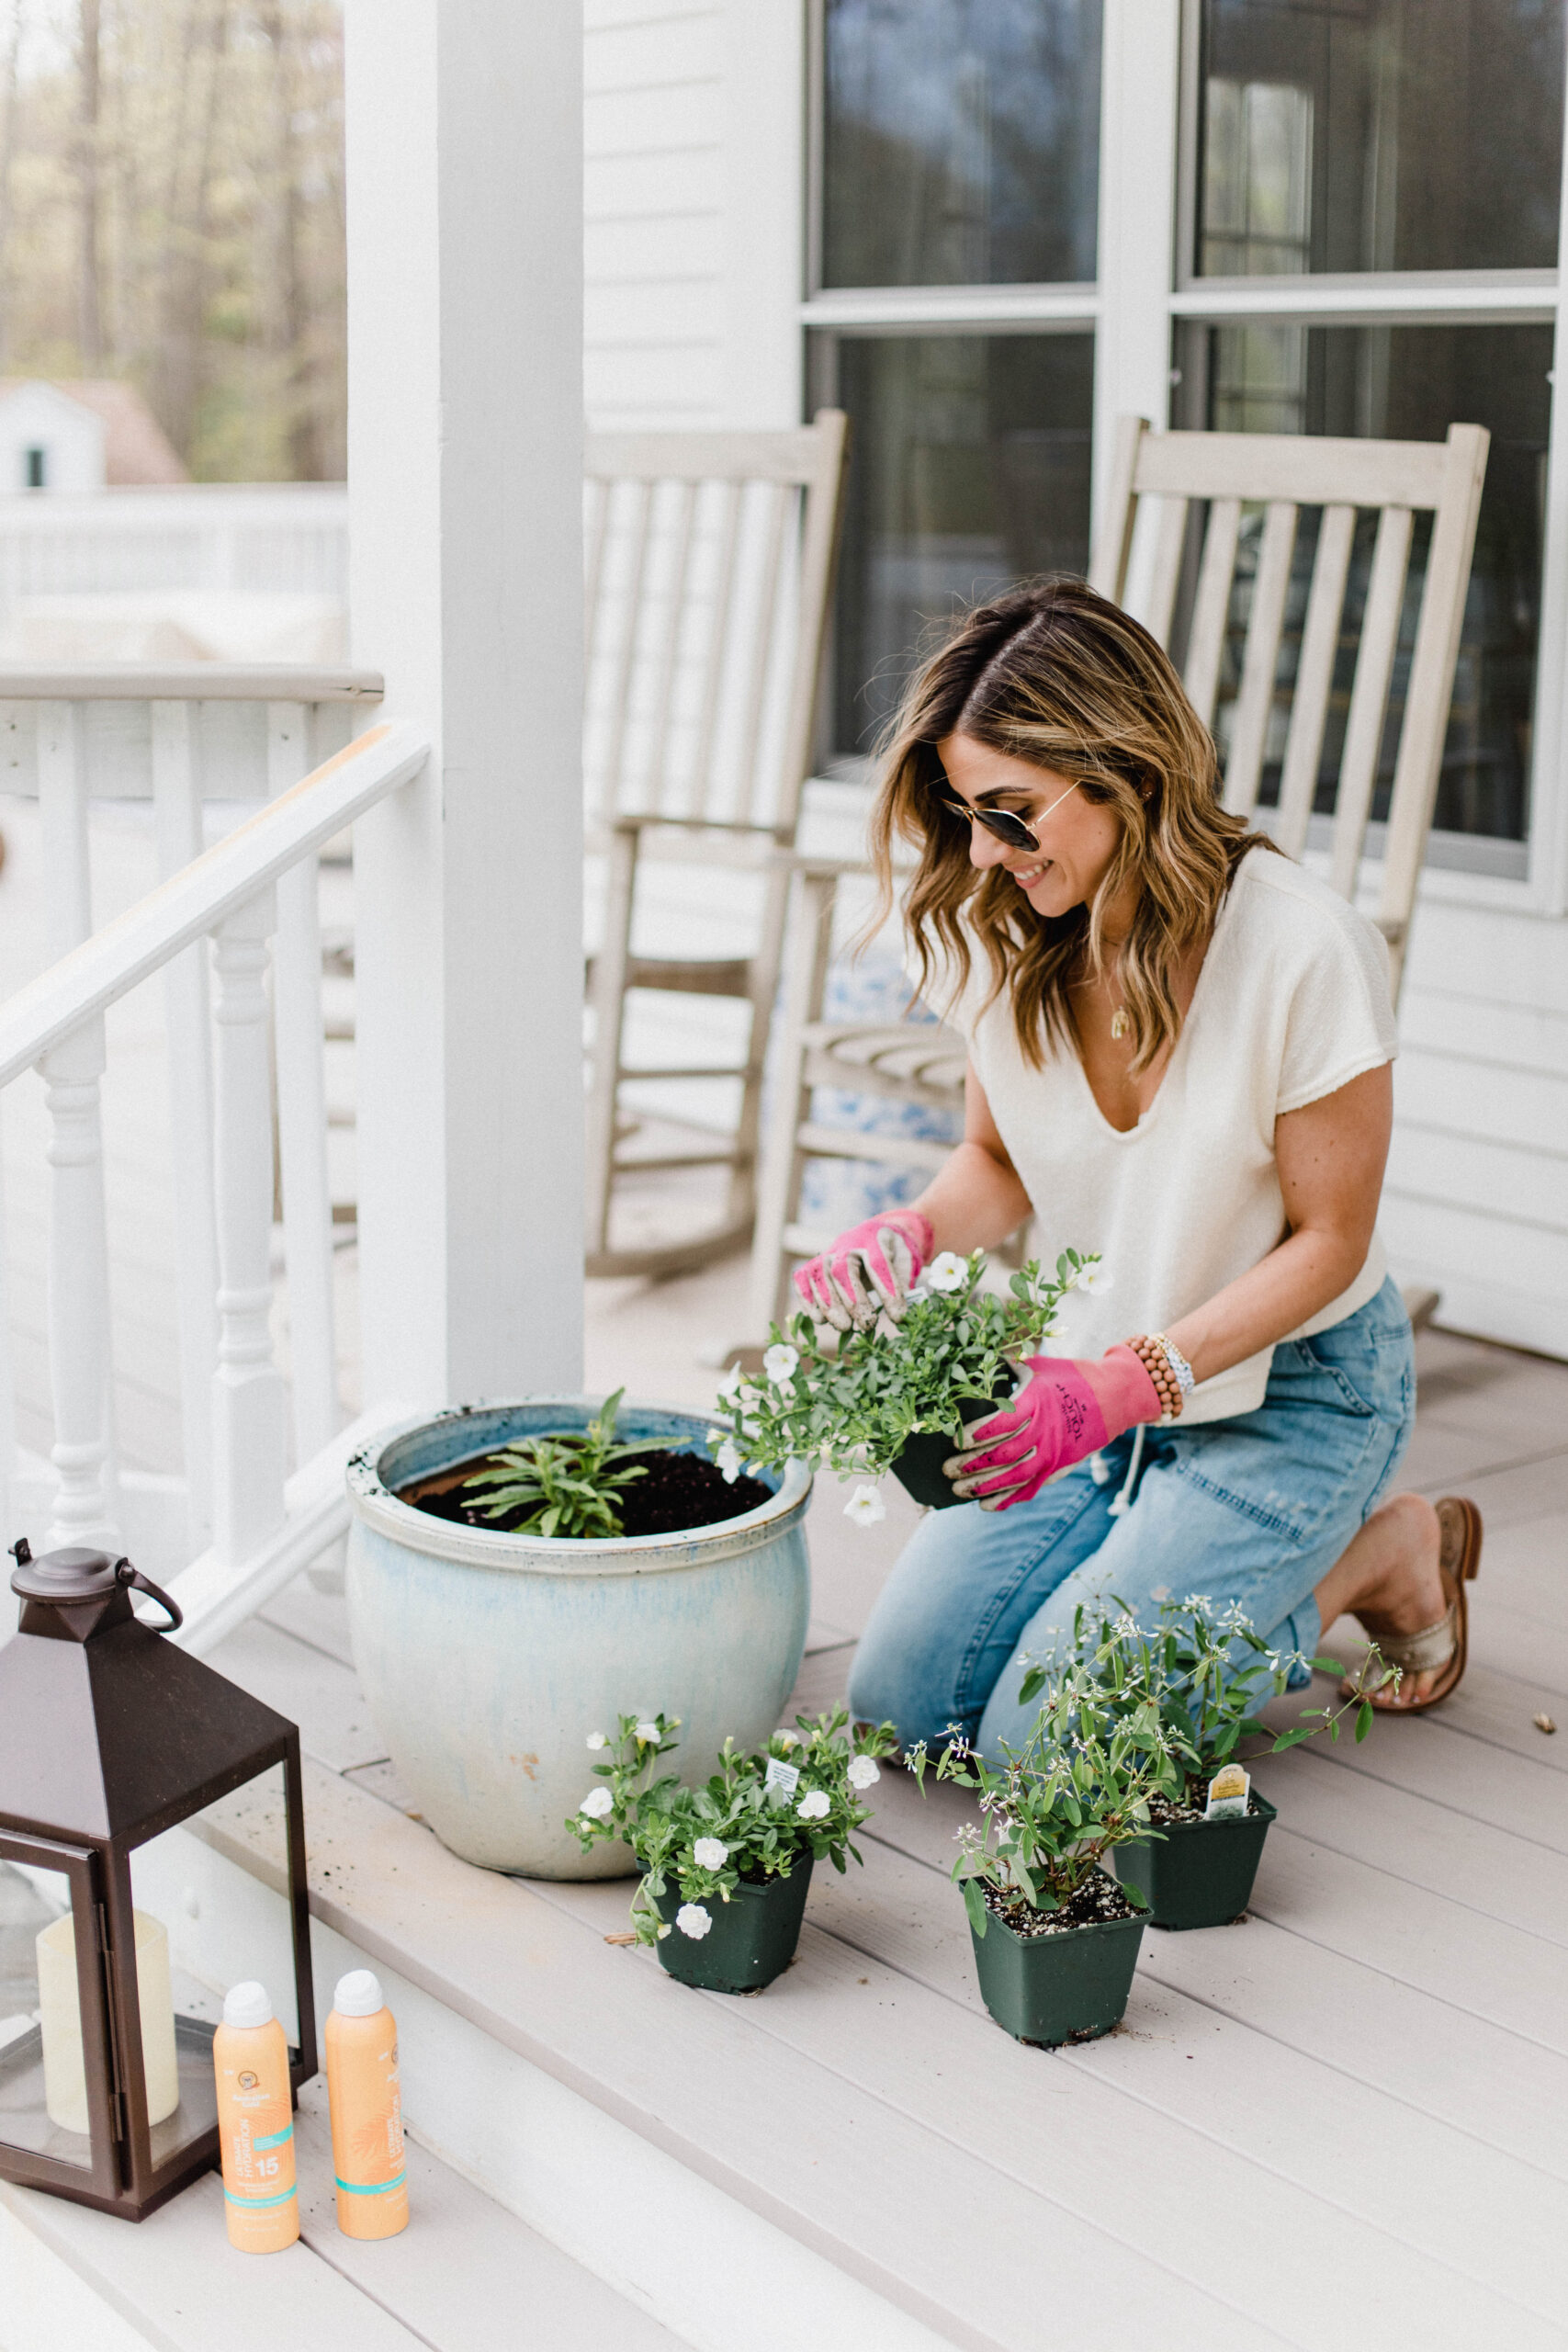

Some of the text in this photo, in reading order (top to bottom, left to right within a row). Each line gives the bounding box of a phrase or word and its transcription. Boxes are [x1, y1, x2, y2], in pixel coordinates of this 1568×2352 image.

[1058, 1386, 1082, 1442] TOUCH
[241, 2119, 253, 2177] HYDRATION
[255, 2157, 278, 2177] 15
